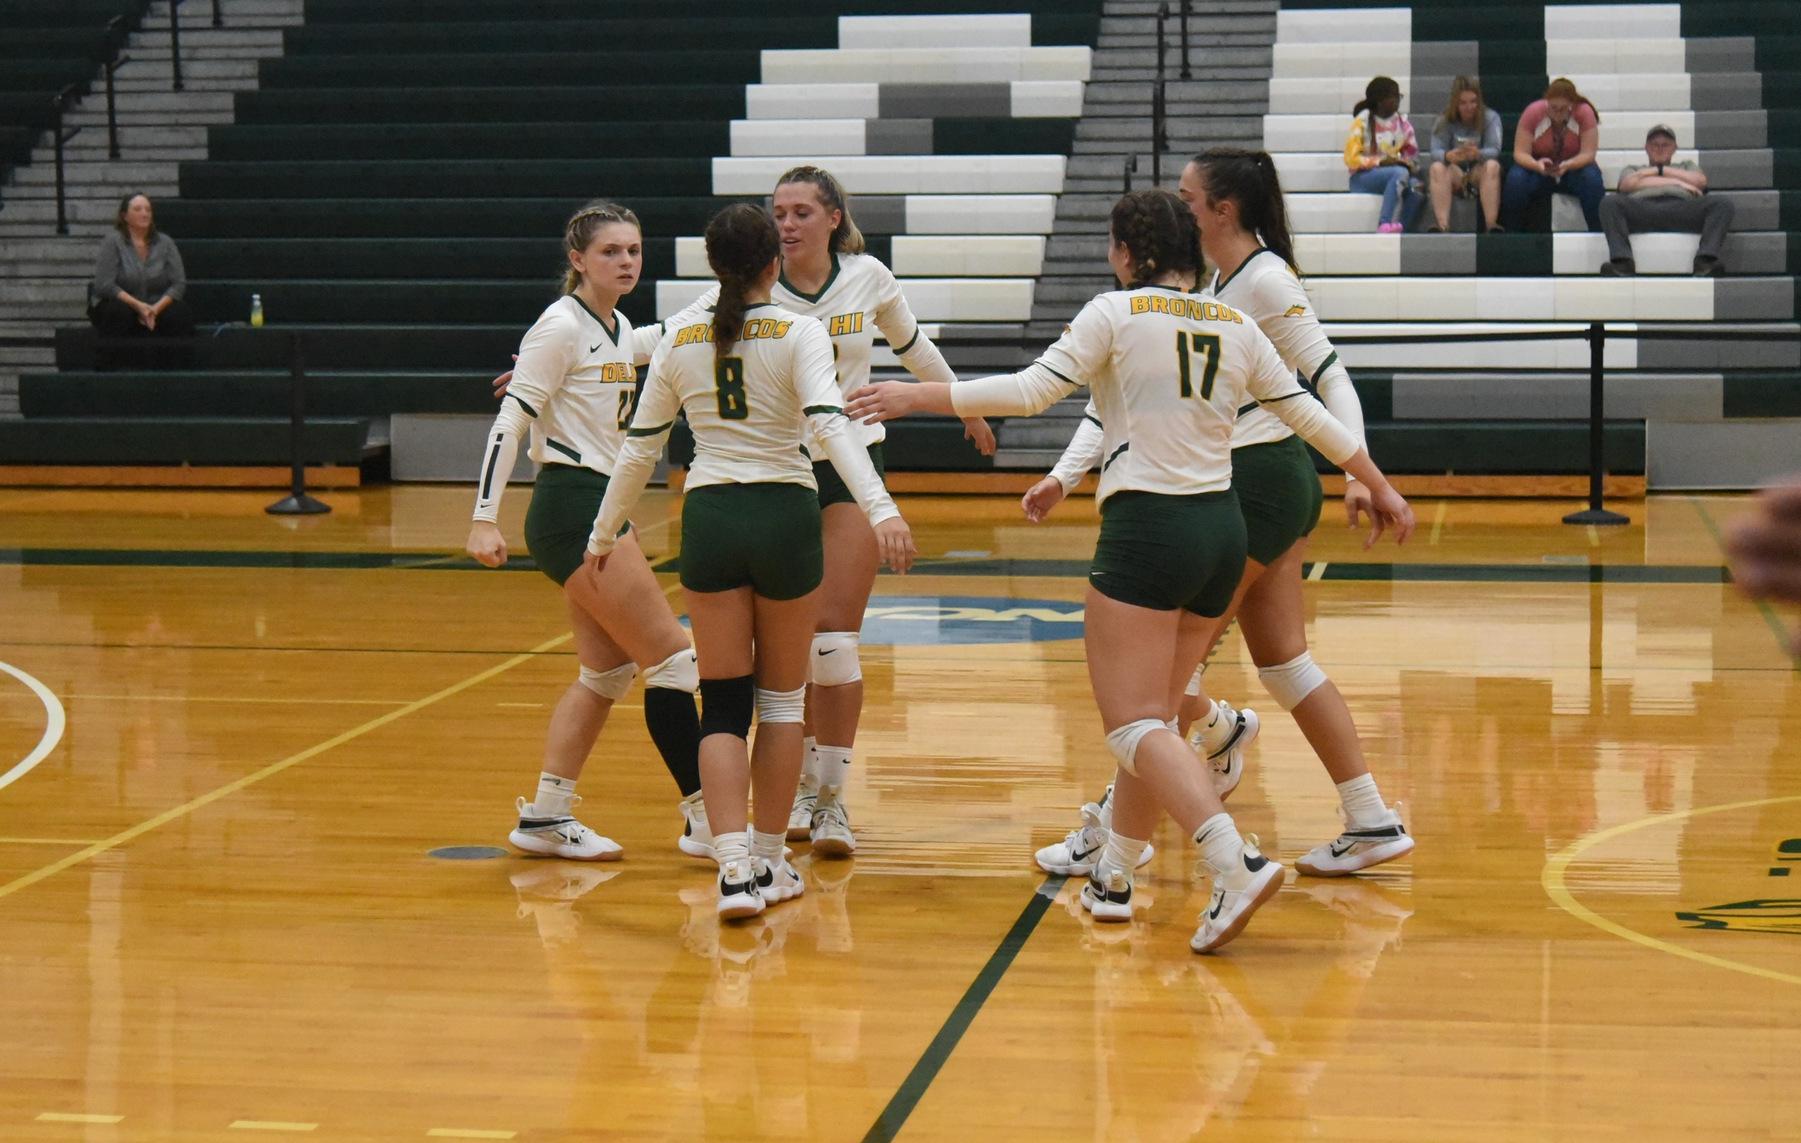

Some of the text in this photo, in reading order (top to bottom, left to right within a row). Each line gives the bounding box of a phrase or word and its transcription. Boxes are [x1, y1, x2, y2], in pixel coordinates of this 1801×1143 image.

[672, 318, 793, 348] BRCOS
[1130, 295, 1243, 325] BRONCOS
[715, 356, 748, 420] 8
[1176, 329, 1222, 401] 17
